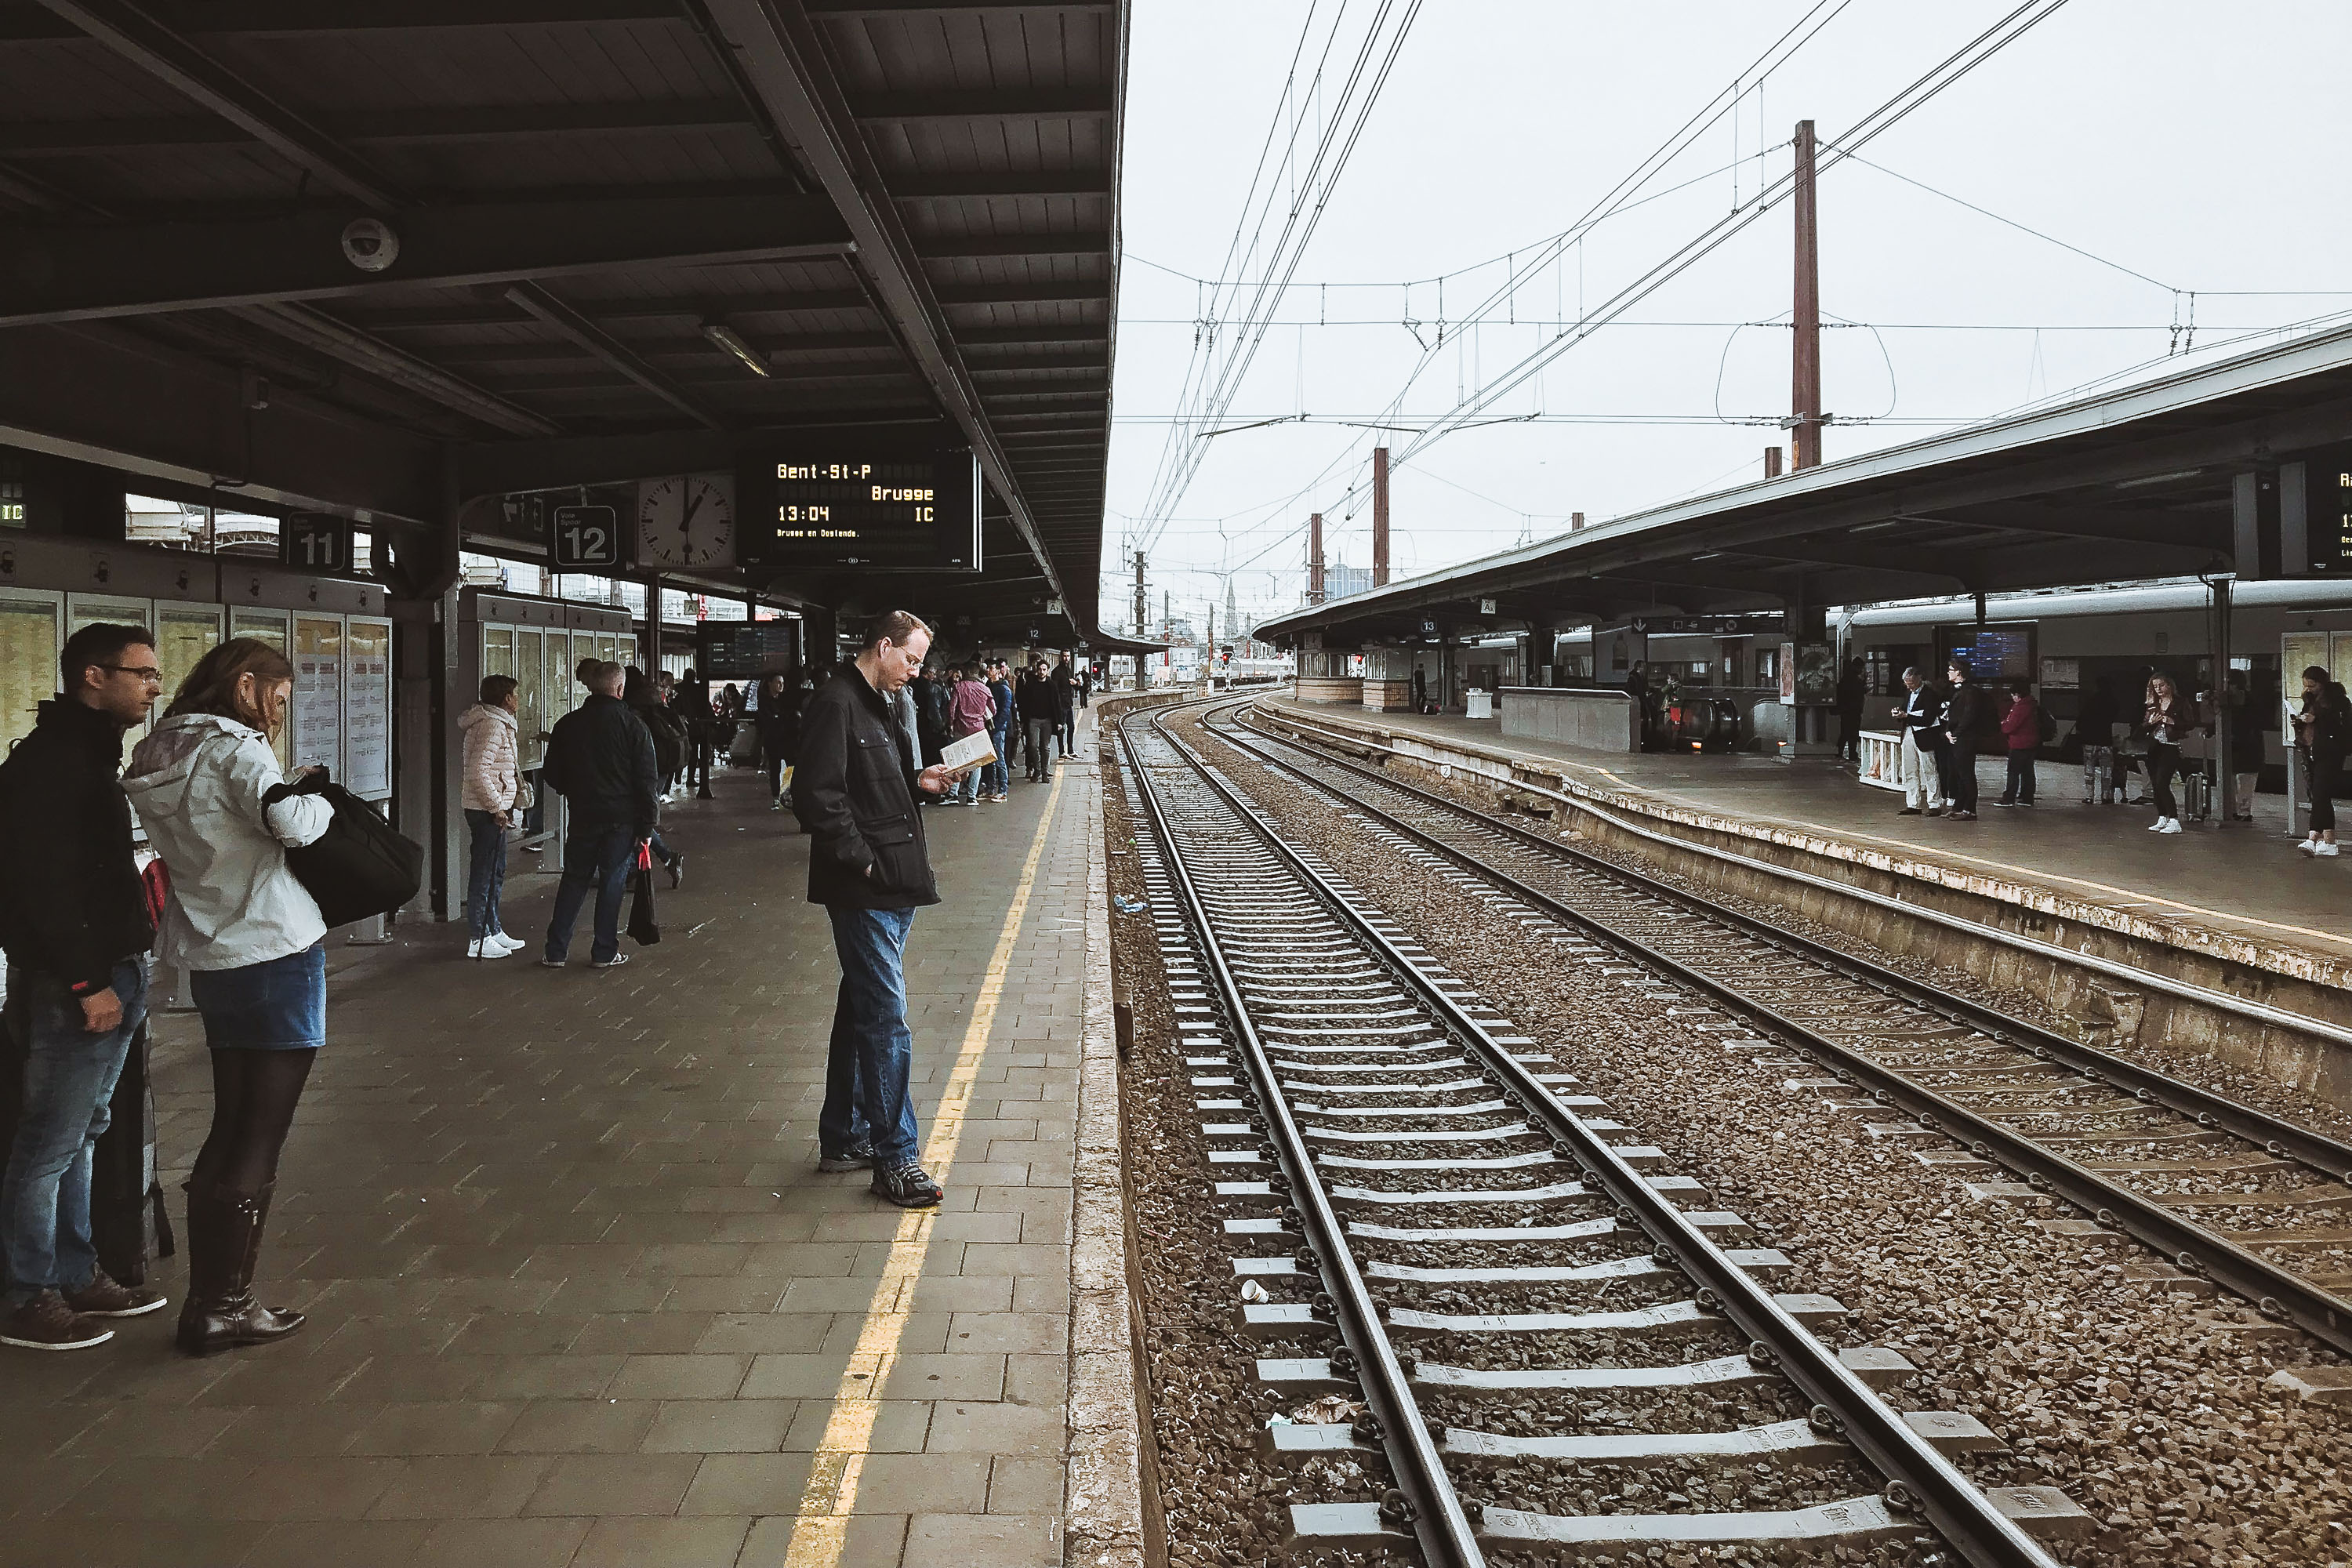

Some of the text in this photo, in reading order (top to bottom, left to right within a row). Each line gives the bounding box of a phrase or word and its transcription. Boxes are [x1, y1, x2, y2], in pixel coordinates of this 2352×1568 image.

[777, 463, 871, 479] Gent-St-P
[872, 485, 934, 501] Brugge
[2, 505, 23, 520] IC
[779, 506, 934, 522] 13:04 IC
[300, 533, 332, 564] 11
[564, 527, 606, 559] 12
[1424, 622, 1435, 630] 13
[1443, 767, 1448, 776] 2
